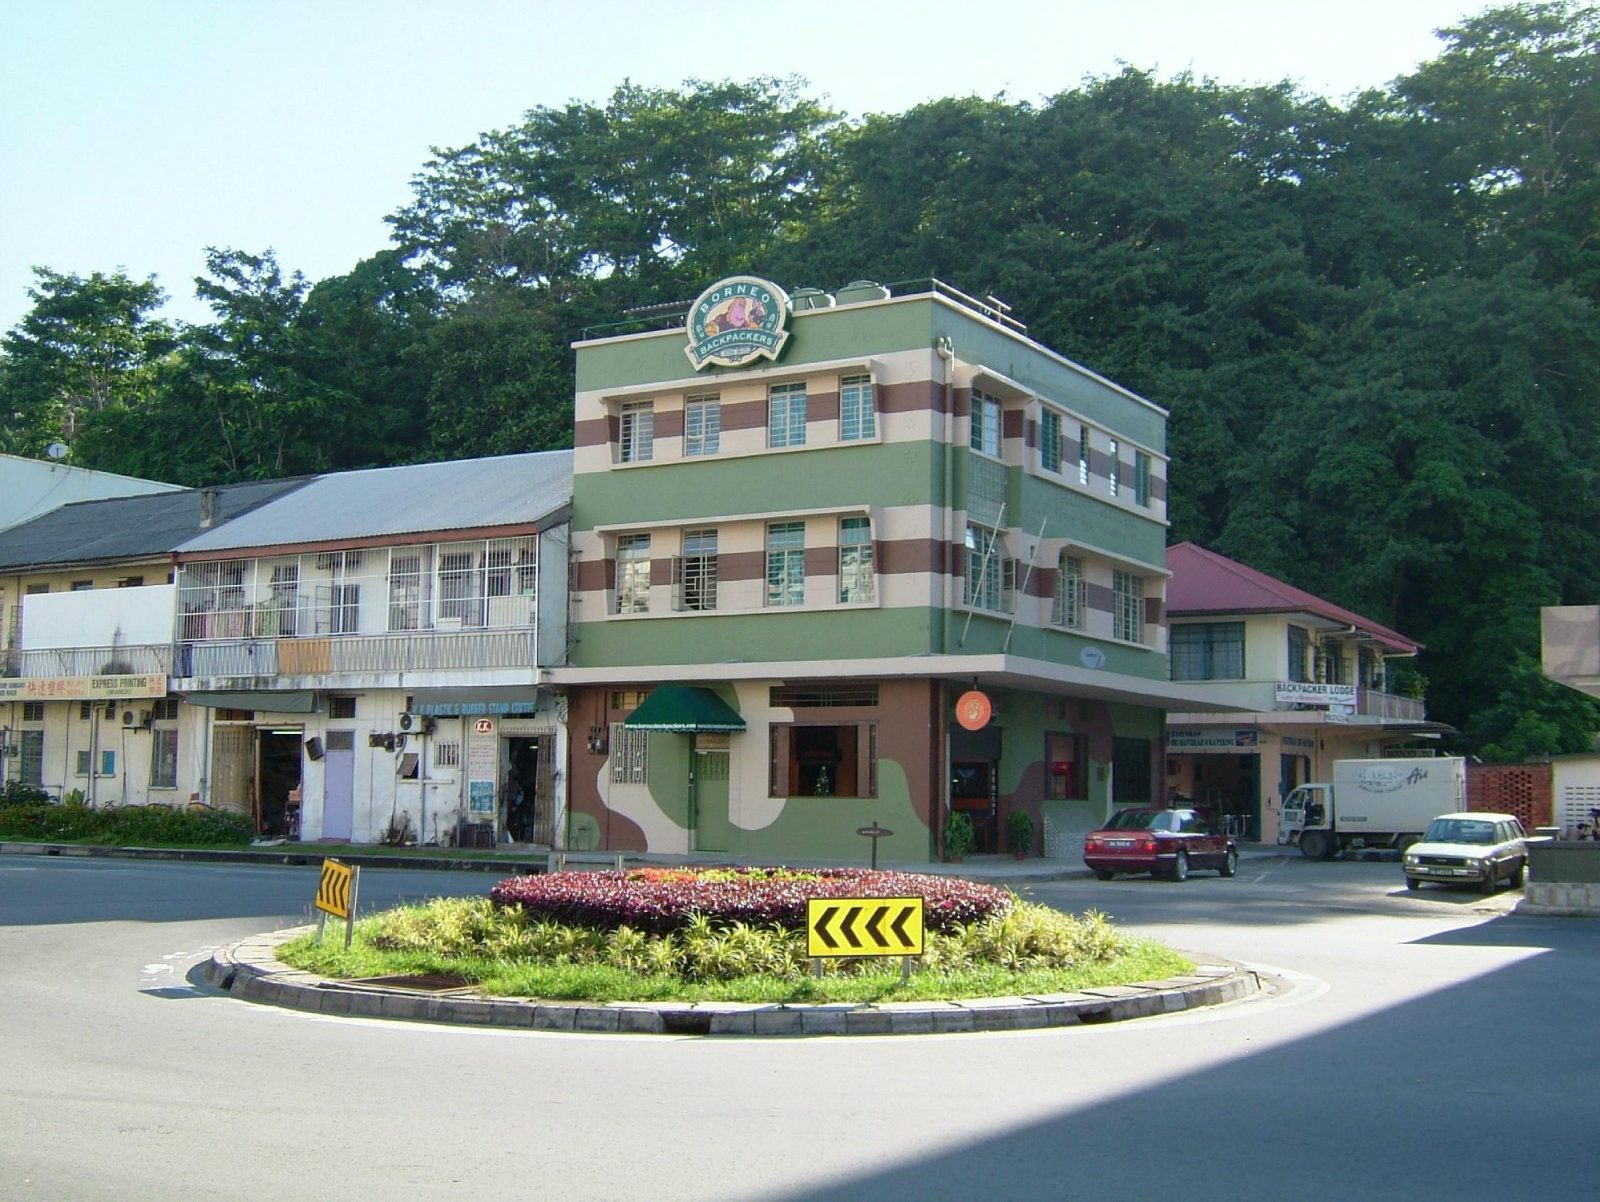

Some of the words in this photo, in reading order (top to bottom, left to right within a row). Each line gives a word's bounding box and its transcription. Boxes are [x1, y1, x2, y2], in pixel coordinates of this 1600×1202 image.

[700, 285, 770, 313] BORNEO
[700, 332, 773, 355] BACKPACKERS
[92, 679, 118, 688] EXPRESS
[119, 677, 147, 687] PRINTING
[1276, 683, 1328, 694] BACKPACKER
[1330, 687, 1355, 695] LODGE
[426, 704, 453, 714] PLASTIC
[462, 703, 486, 714] RUBBER
[488, 702, 510, 713] STAMP
[511, 702, 534, 712] CENTRE
